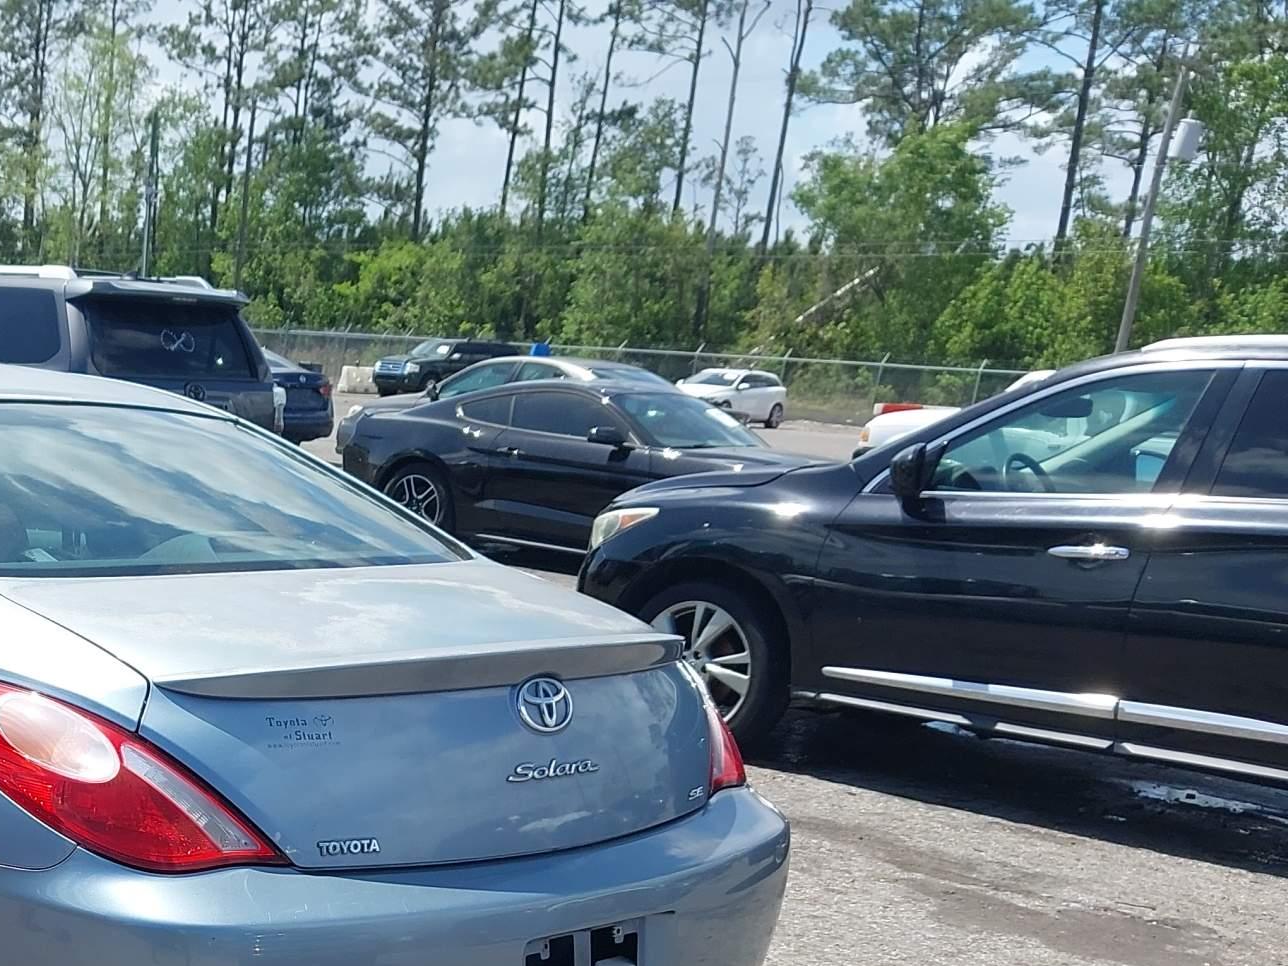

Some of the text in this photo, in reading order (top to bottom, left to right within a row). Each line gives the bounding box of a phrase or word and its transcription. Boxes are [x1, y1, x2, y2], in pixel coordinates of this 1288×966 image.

[265, 717, 307, 728] Toyota
[295, 730, 332, 740] Stuart
[507, 759, 600, 782] Solara
[688, 786, 704, 800] SE
[317, 839, 381, 856] TOYOTA
